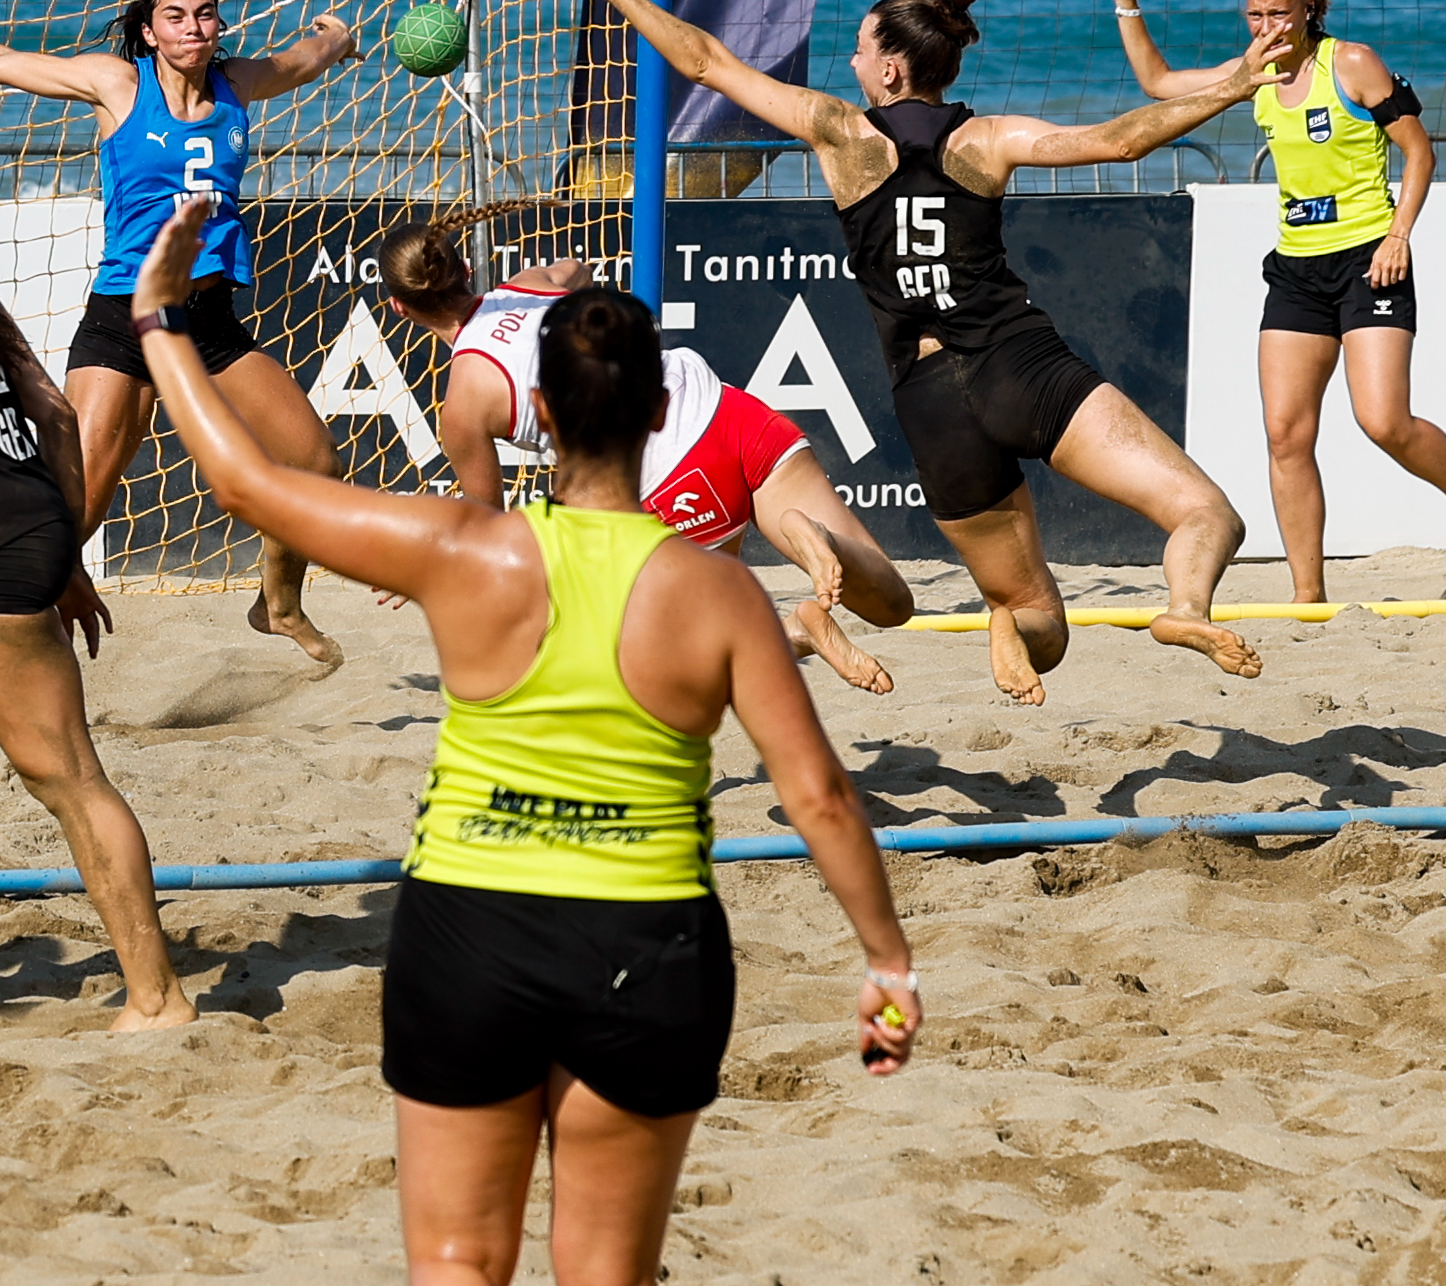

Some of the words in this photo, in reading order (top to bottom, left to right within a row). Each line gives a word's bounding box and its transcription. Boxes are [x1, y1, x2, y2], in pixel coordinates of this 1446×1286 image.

[184, 137, 214, 191] 2
[896, 197, 946, 257] 15
[896, 263, 958, 311] GER
[490, 311, 528, 344] POL
[675, 510, 716, 532] ORLEN
